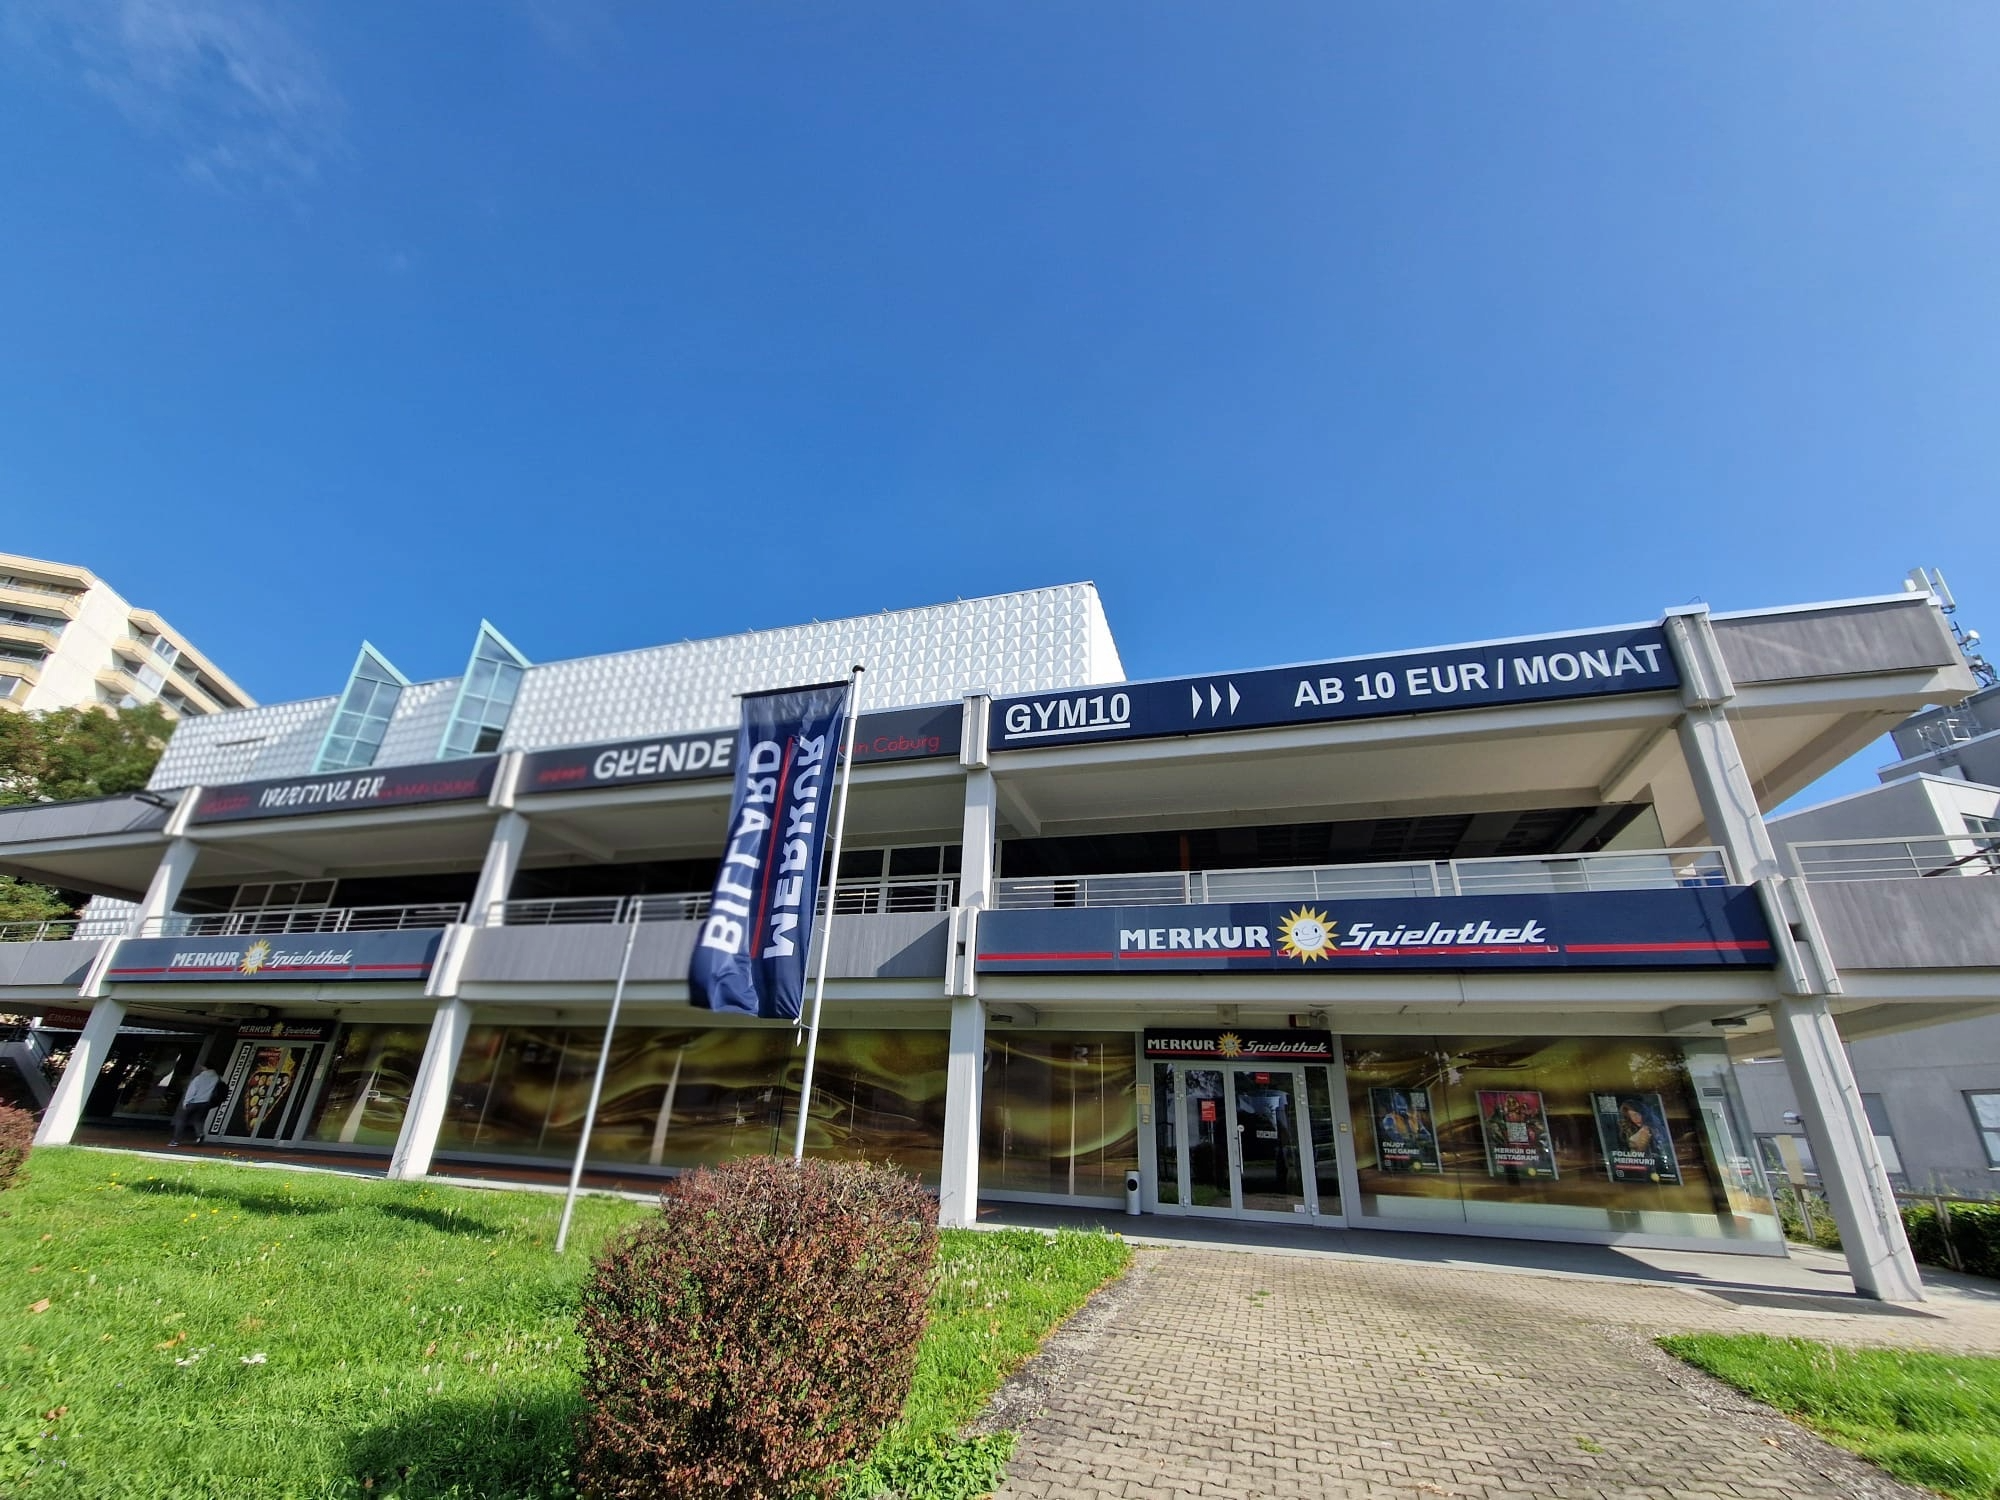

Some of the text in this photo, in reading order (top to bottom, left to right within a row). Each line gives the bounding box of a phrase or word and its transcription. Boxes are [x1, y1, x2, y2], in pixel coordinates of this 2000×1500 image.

[1294, 677, 1345, 707] AB
[1355, 671, 1396, 701] 10
[1407, 662, 1489, 696] EUR
[1514, 643, 1662, 686] MONAT
[1005, 693, 1131, 733] GYM10
[873, 735, 941, 753] Coburg
[1119, 919, 1546, 951] MERKUR Spielothek
[170, 948, 353, 968] MERKUR Spielothek
[238, 1024, 272, 1034] MERKUR
[1147, 1039, 1327, 1054] MERKUR Spielothek
[1612, 1150, 1645, 1158] FOLLOW
